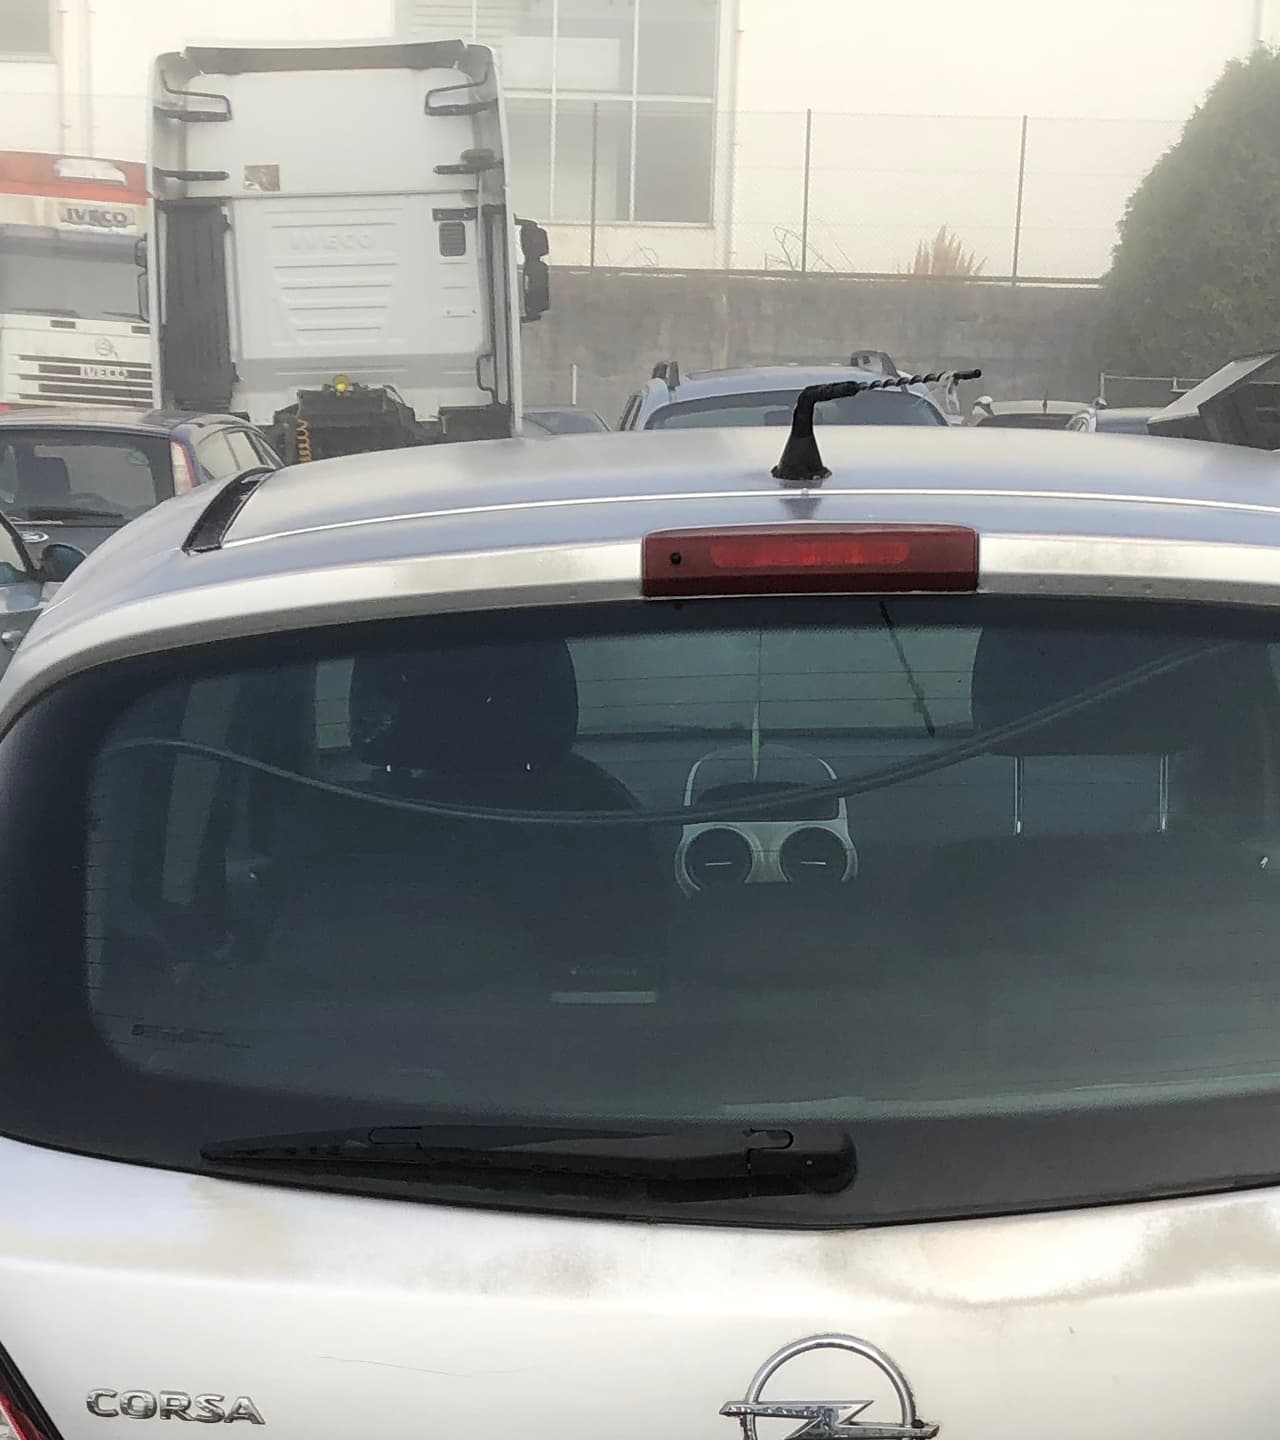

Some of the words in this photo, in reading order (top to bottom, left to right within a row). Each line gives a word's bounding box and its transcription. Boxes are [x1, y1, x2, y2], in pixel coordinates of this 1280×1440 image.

[64, 206, 129, 228] IVECO
[79, 366, 128, 381] IVECO
[86, 1388, 266, 1425] CORSA
